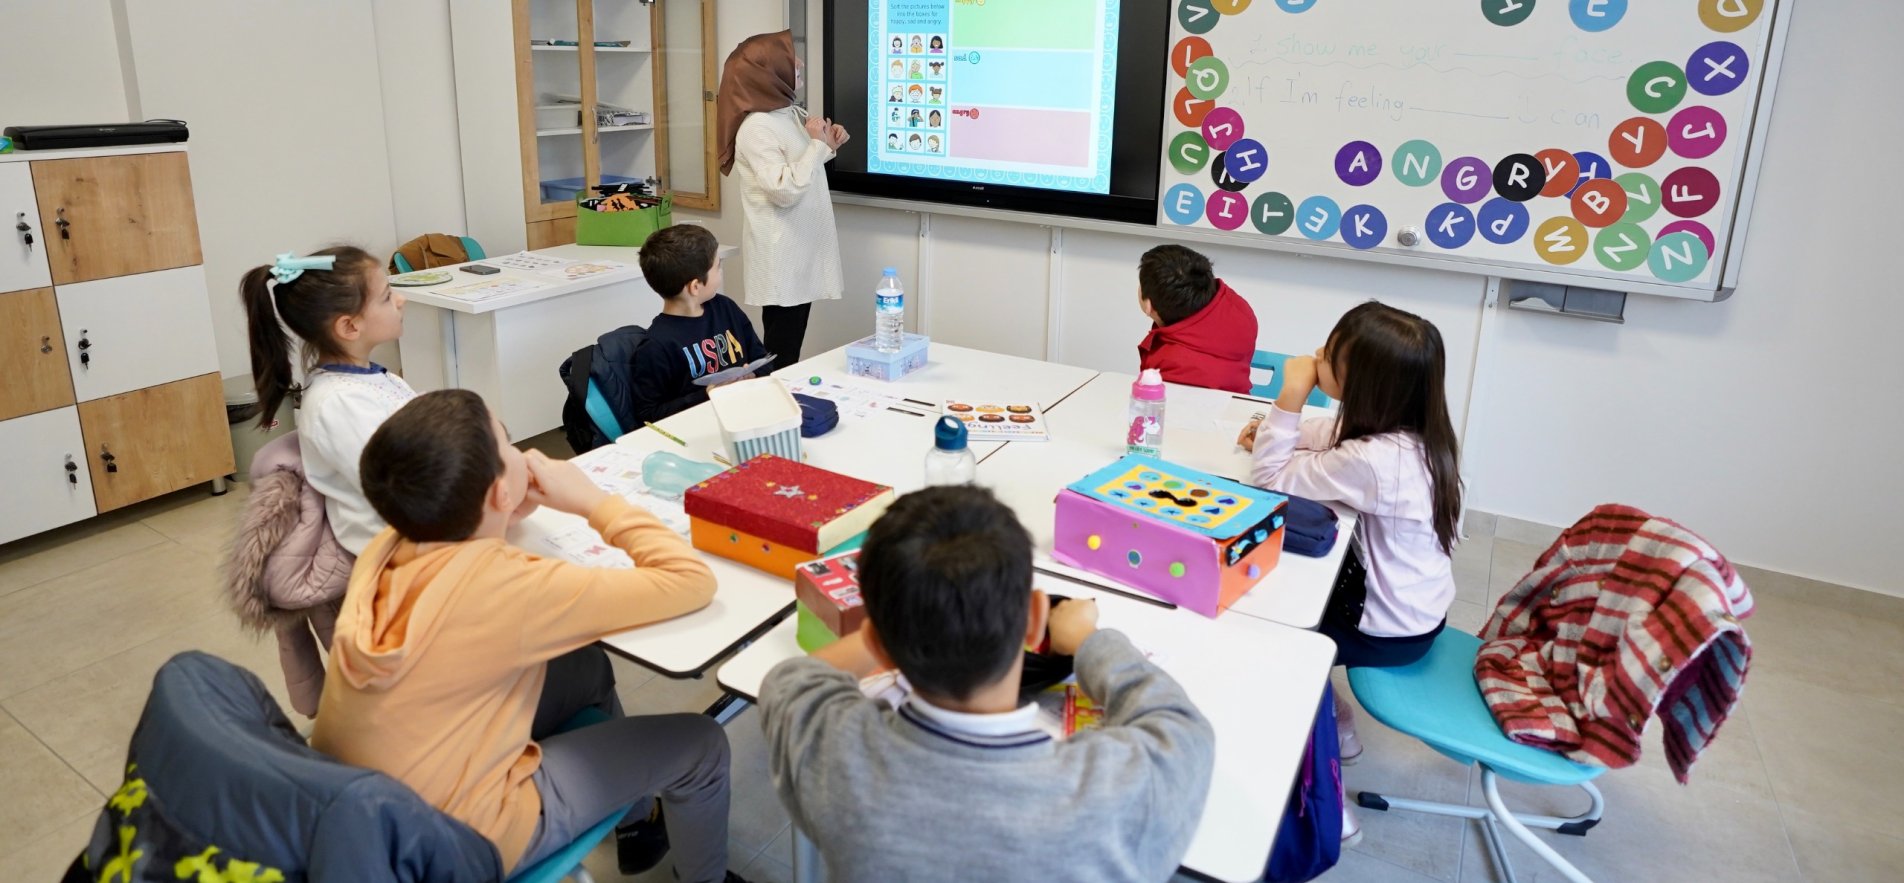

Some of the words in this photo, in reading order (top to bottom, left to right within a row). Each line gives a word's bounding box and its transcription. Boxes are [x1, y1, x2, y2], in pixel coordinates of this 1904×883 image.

[1348, 43, 1378, 57] me
[1400, 40, 1448, 67] your
[1704, 55, 1736, 82] X
[952, 109, 970, 117] angry
[1335, 80, 1404, 122] feeling
[1621, 125, 1645, 154] Y
[1176, 190, 1194, 215] E
[1354, 213, 1374, 238] K
[1438, 211, 1465, 238] K
[683, 329, 744, 379] USPA
